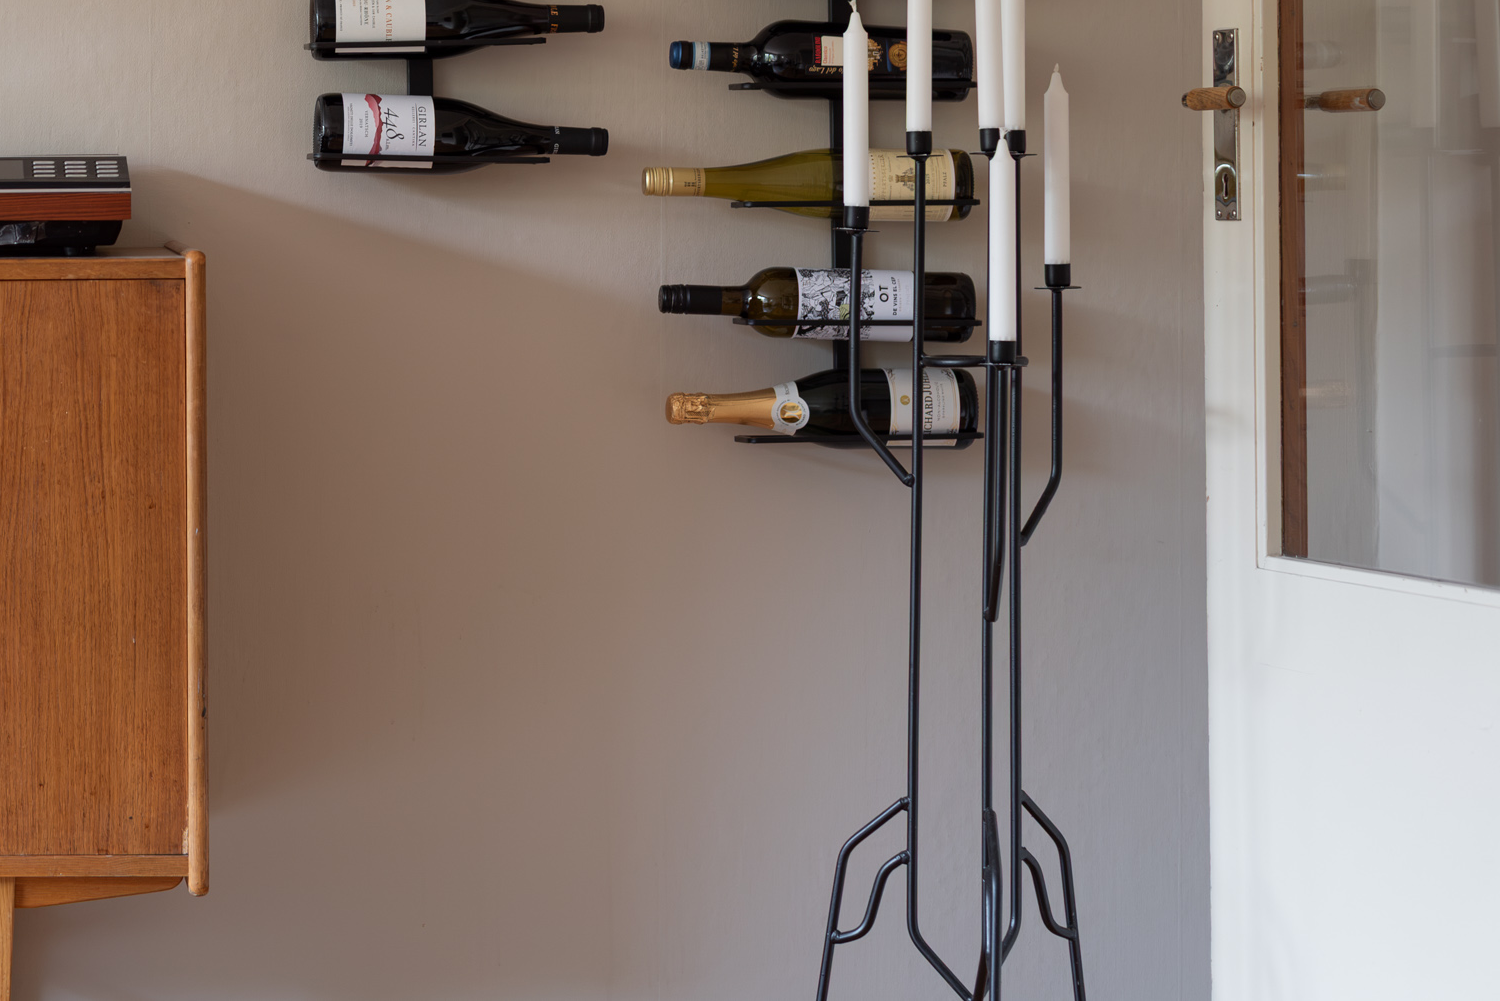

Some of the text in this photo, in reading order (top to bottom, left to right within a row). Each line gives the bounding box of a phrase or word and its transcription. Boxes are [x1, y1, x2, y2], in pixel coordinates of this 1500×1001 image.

[382, 107, 405, 140] 448
[418, 106, 427, 147] GIRLAN
[878, 285, 890, 303] OT
[892, 308, 898, 316] DE
[923, 396, 933, 434] ICHARD
